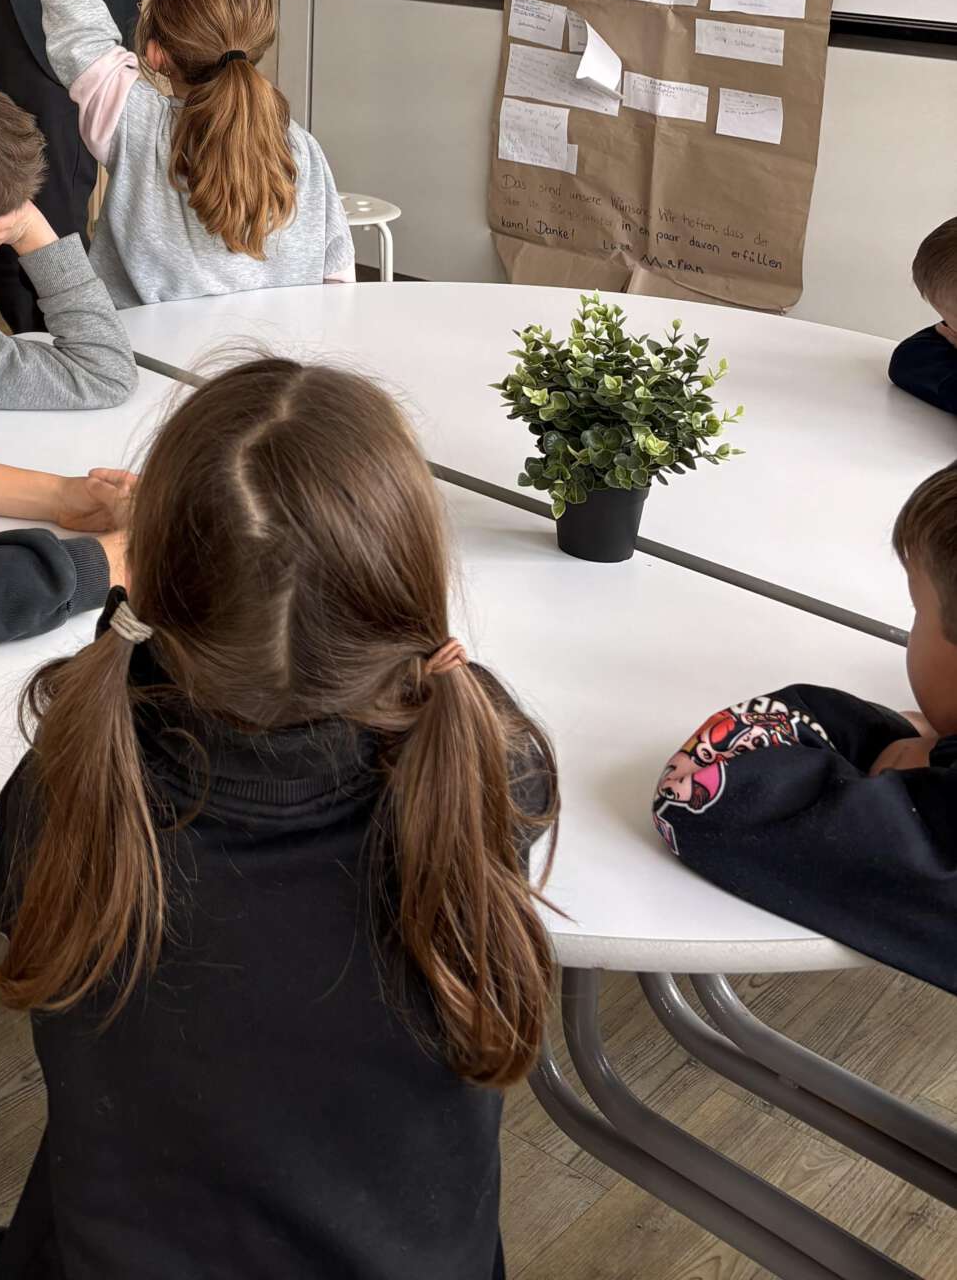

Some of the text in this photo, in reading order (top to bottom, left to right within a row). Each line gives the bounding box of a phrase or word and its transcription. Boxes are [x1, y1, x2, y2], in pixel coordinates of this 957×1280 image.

[501, 174, 527, 191] Das
[570, 191, 602, 206] unsere
[658, 207, 676, 224] Wir
[500, 216, 575, 241] kann! Danke!
[656, 231, 680, 245] paar
[689, 235, 720, 256] davon
[731, 250, 783, 270] erfüllen
